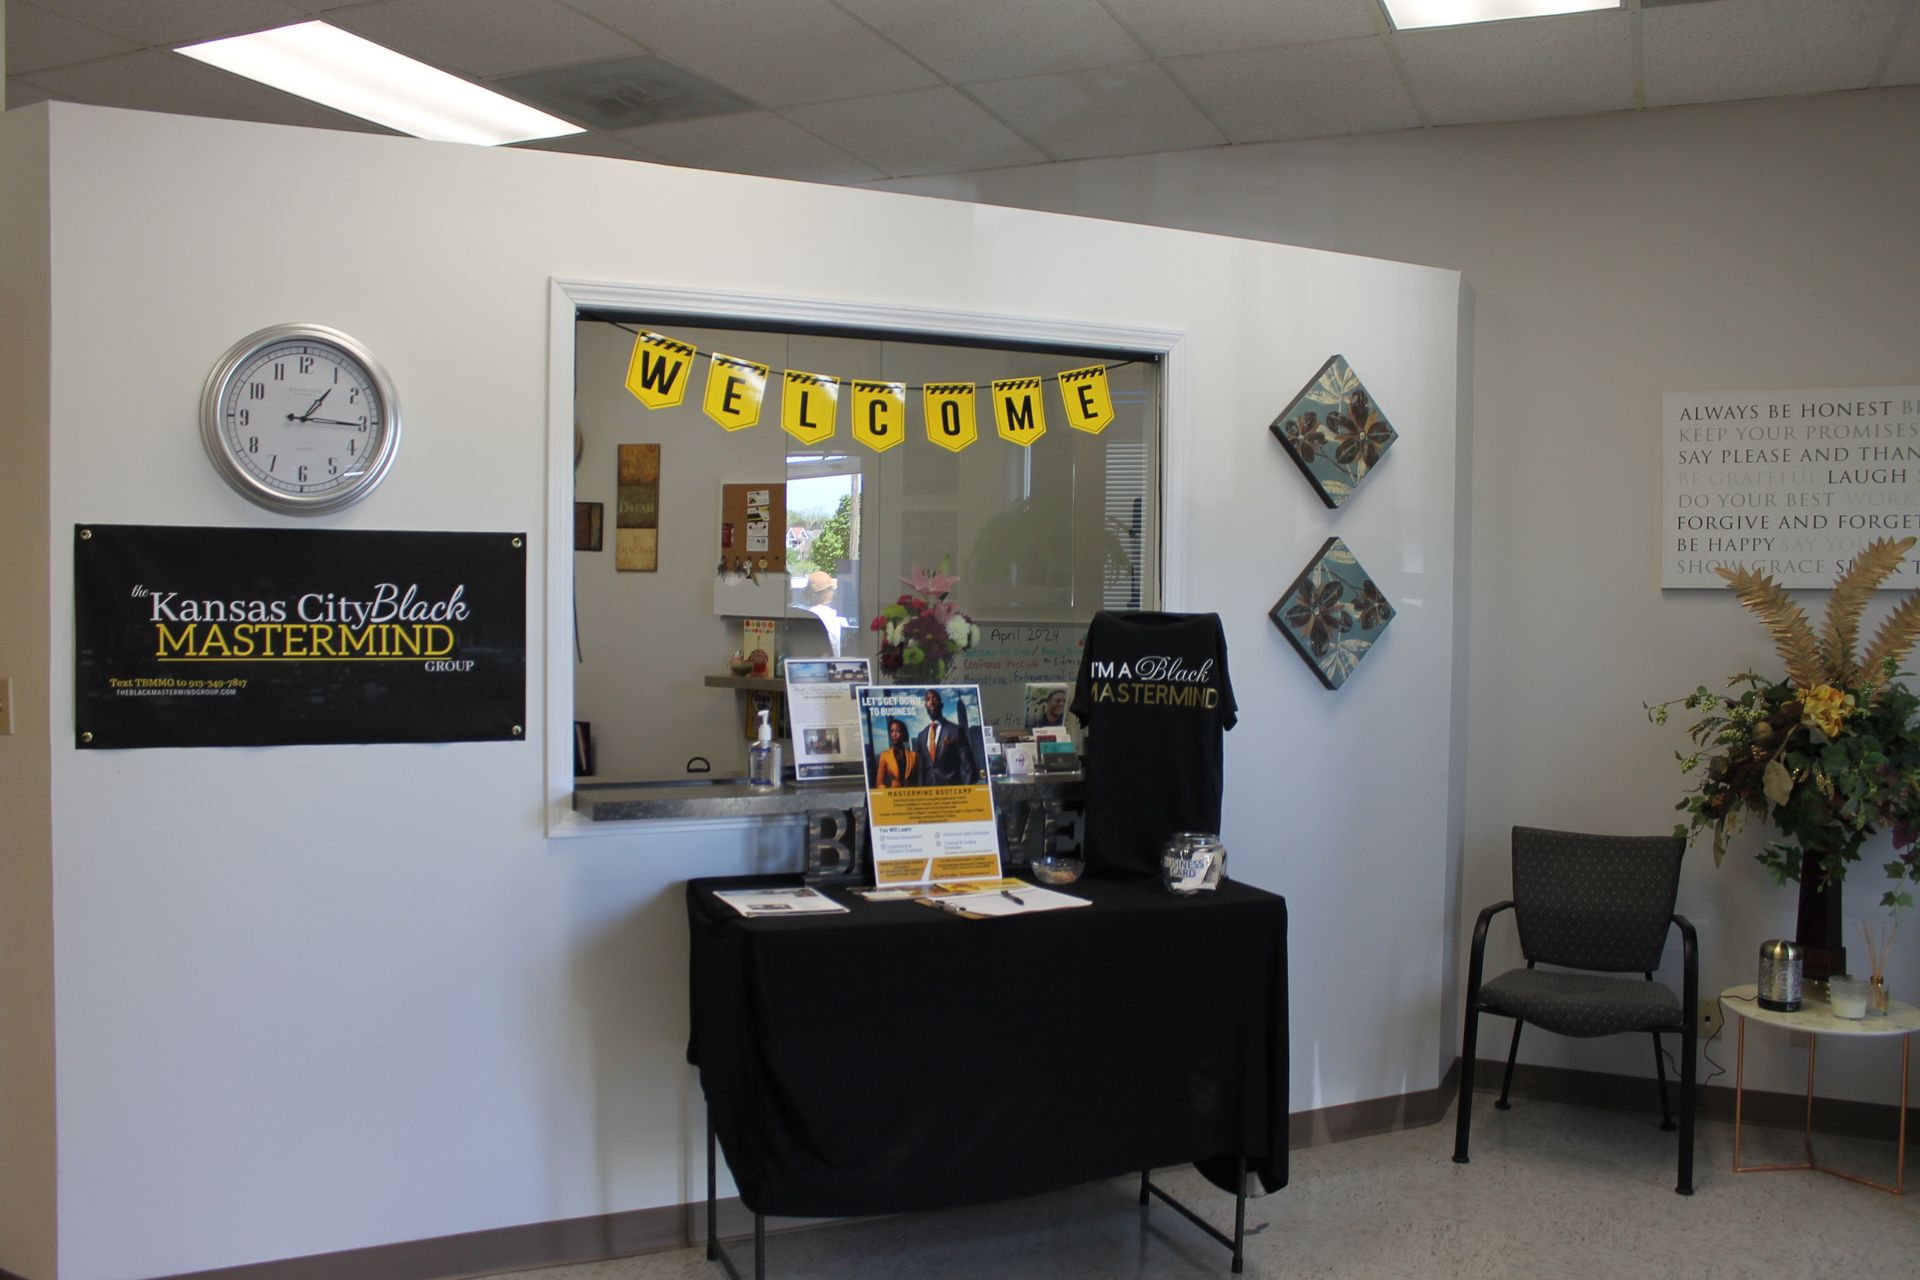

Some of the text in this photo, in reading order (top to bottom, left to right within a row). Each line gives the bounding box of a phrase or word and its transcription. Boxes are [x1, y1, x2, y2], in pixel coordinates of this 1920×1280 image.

[274, 363, 286, 381] 11
[299, 356, 314, 375] 12
[333, 367, 338, 384] 1
[249, 382, 265, 400] 10
[349, 387, 359, 405] 2
[640, 349, 1099, 436] WELCOME
[239, 408, 249, 426] 9
[1679, 404, 1759, 421] ALWAYS
[1768, 403, 1791, 419] BE
[1800, 401, 1893, 418] HONEST
[358, 416, 367, 433] 3
[1679, 422, 1918, 443] KEEP YOUR PROMISES
[249, 436, 259, 453] 8
[346, 439, 357, 456] 4
[268, 454, 278, 472] 7
[1678, 449, 1713, 465] SAY
[1721, 448, 1791, 464] PLEASE
[1799, 447, 1849, 463] AND
[298, 465, 308, 482] 6
[328, 457, 337, 475] 5
[1679, 472, 1701, 486] BE
[1710, 471, 1816, 486] GRATEFUL
[1828, 468, 1907, 484] LAUGH
[1678, 491, 1917, 508] DO YOUR BEST WORK
[1677, 515, 1770, 530] FORGIVE
[1778, 515, 1828, 530] AND
[1677, 538, 1699, 552] BE
[1708, 537, 1775, 552] HAPPY
[1782, 537, 1816, 551] SAY
[1676, 560, 1741, 574] SHOW
[1752, 559, 1824, 574] GRACE
[131, 583, 470, 630] the Kansas City Black
[155, 623, 455, 656] MASTERMIND
[991, 628, 1059, 644] April 2024
[424, 660, 475, 673] GROUP
[1091, 661, 1114, 679] I'M
[1117, 661, 1133, 680] A
[1135, 655, 1214, 684] Black
[109, 678, 132, 688] Text
[134, 678, 175, 688] TBMMG
[176, 678, 187, 688] to
[883, 696, 897, 706] GET
[869, 707, 880, 717] TO
[881, 707, 916, 716] BUSINESS
